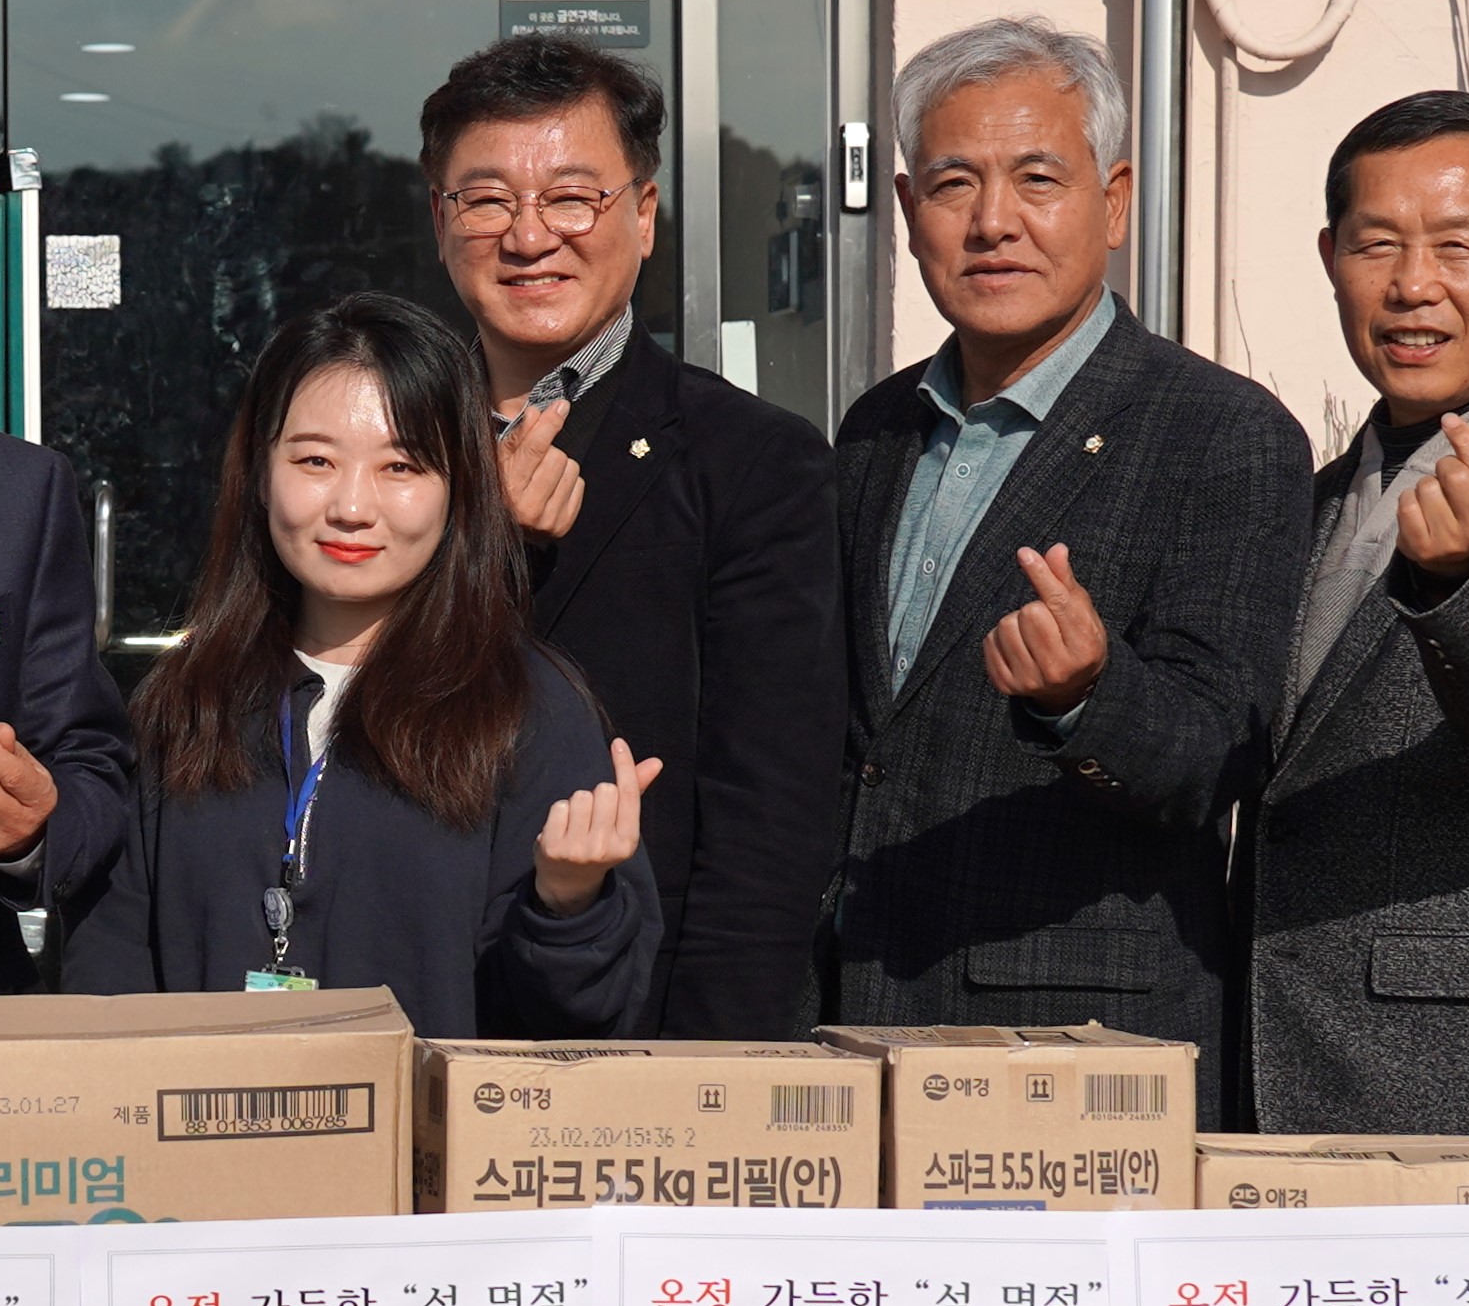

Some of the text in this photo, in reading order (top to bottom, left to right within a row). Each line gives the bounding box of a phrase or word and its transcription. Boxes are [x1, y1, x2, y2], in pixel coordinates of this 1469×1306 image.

[509, 1087, 551, 1111] 애경
[953, 1078, 989, 1098] 애경
[113, 1105, 151, 1125] 제품
[530, 1126, 675, 1148] 23.02.20/15:36
[473, 1155, 842, 1208] 스파크 5.5 kg 리필(안)
[923, 1148, 1160, 1199] 스파크 5.5 kg 리필(안)
